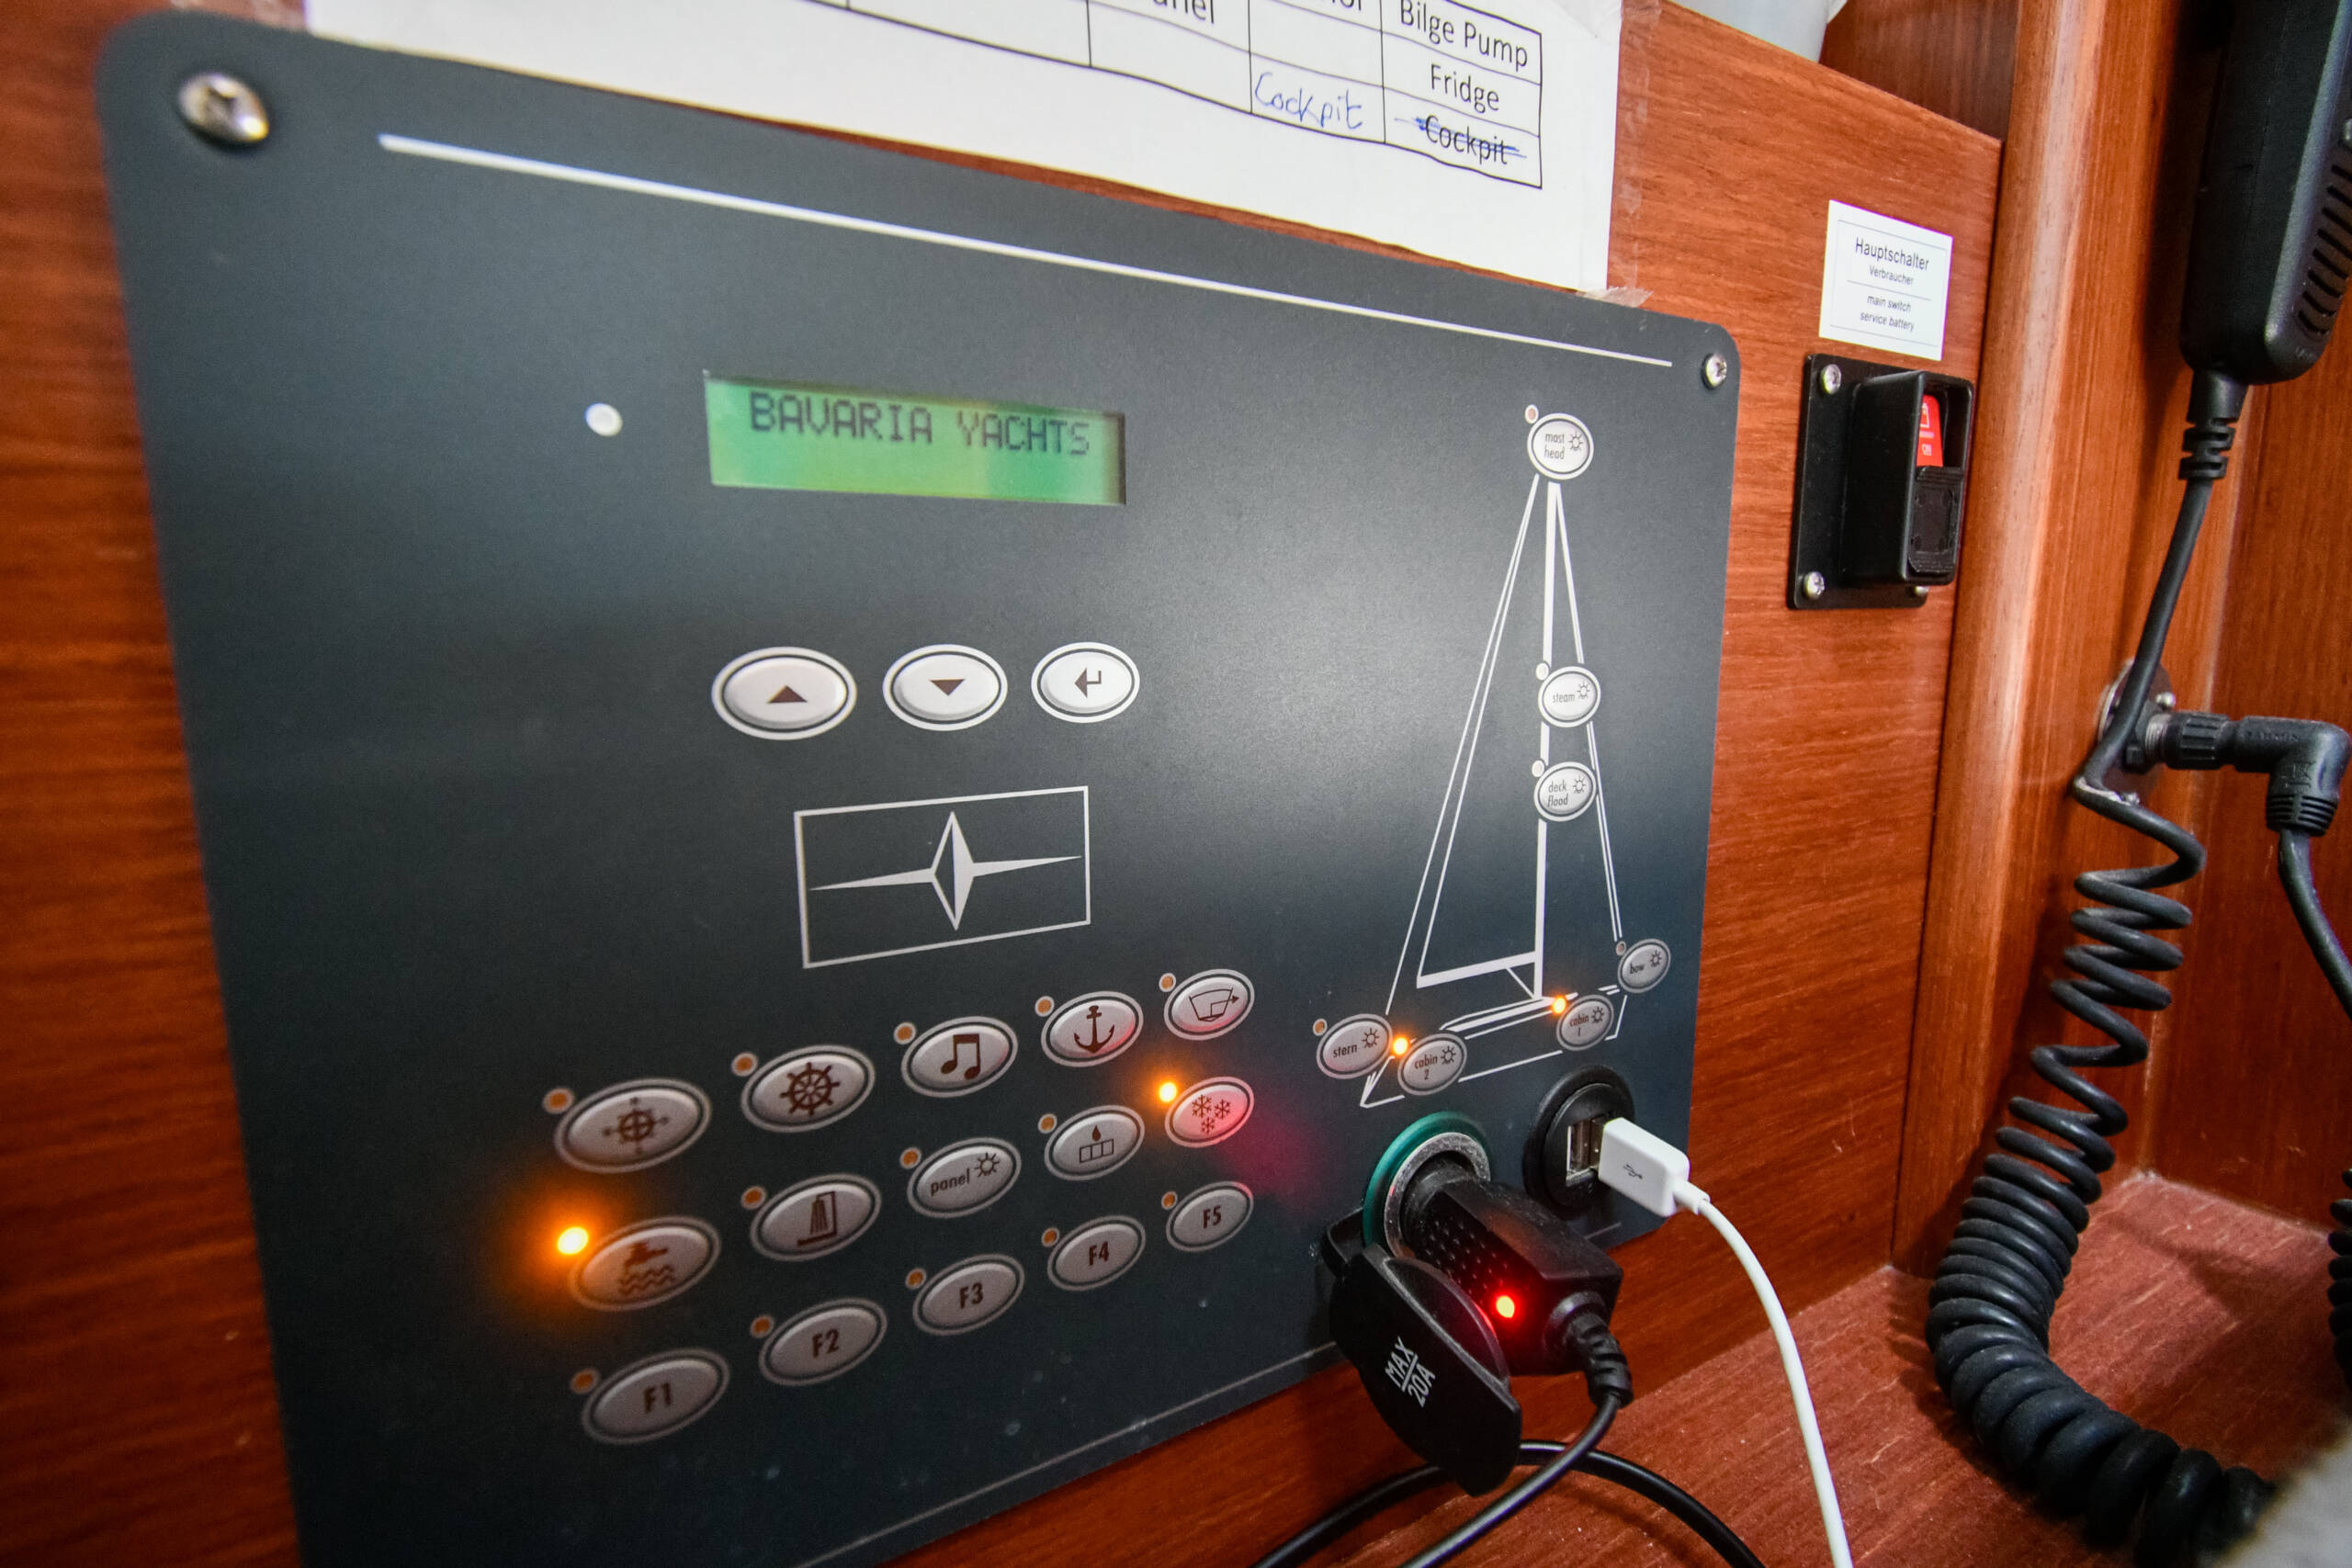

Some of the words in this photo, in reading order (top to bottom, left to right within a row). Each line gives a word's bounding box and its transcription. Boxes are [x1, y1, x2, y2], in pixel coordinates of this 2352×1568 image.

[1400, 0, 1454, 44] Bilge
[1464, 22, 1528, 72] Pump
[1430, 63, 1499, 114] Fridge
[1254, 72, 1363, 130] Cockpit
[1425, 115, 1508, 164] Cockpit
[1855, 236, 1929, 271] Hauptschalter
[1869, 265, 1915, 286] Verbraucher
[1867, 295, 1886, 308] main
[1887, 299, 1911, 313] switch
[1860, 311, 1887, 325] service
[1889, 313, 1914, 333] battery
[749, 391, 933, 445] BAVARIA
[956, 410, 1091, 456] YACHTS
[1544, 445, 1565, 459] head
[1553, 693, 1576, 704] steam
[1548, 782, 1567, 793] deck
[1547, 794, 1568, 807] flood
[1629, 963, 1645, 975] bow
[1569, 1013, 1589, 1027] cabin
[1333, 1043, 1358, 1058] stern
[1414, 1055, 1438, 1069] cabin
[1423, 1069, 1430, 1080] 2
[930, 1168, 970, 1198] panel
[1203, 1205, 1222, 1228] F5
[1089, 1241, 1110, 1266] F4
[959, 1283, 984, 1309] F3
[812, 1329, 840, 1359] F2
[1385, 1336, 1415, 1389] MAX
[1408, 1363, 1436, 1408] 20A
[644, 1382, 672, 1414] F1
